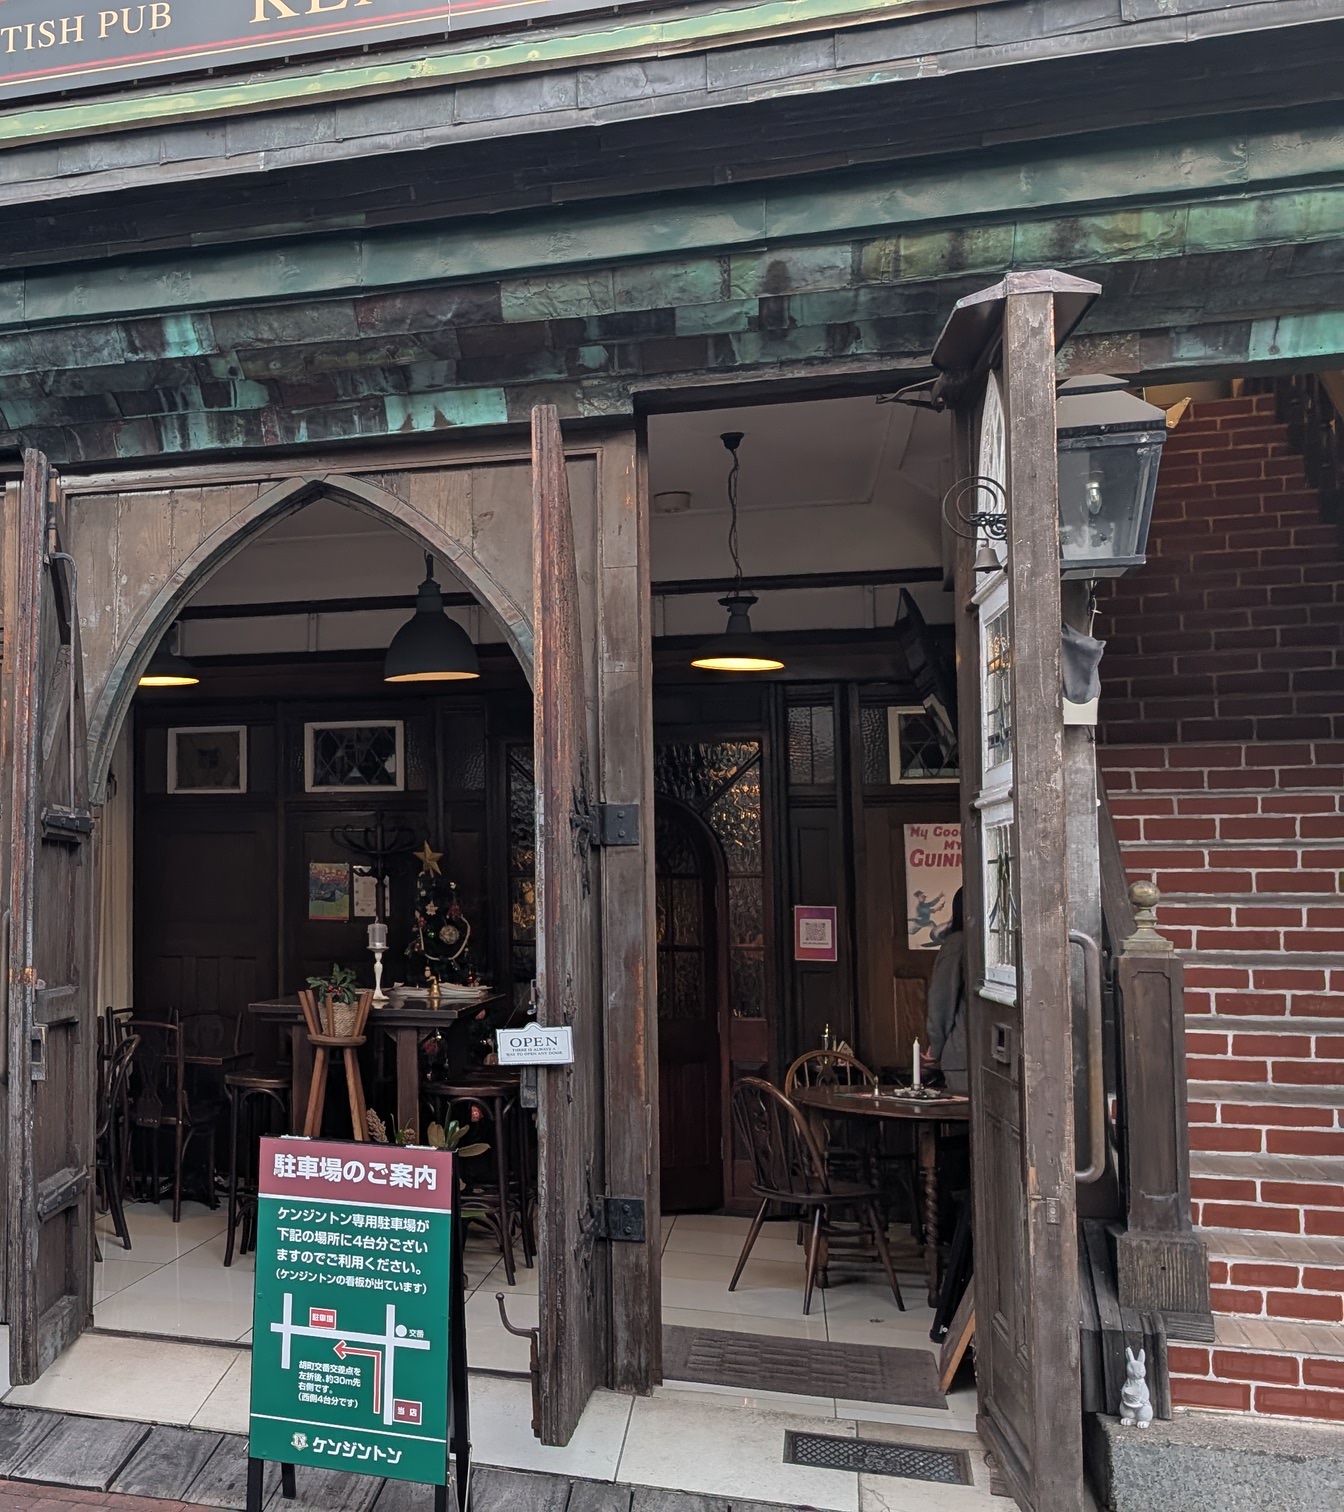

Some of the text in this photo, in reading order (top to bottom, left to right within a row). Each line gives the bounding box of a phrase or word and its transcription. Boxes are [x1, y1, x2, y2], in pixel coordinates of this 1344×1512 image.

[97, 2, 172, 39] PUB
[910, 826, 961, 840] My Goo
[509, 1036, 558, 1048] OPEN
[273, 1153, 437, 1191] 駐車場のご案内
[277, 1207, 430, 1233] ケンジントン専用駐車場が
[276, 1227, 428, 1253] 下記の場所に4台分ござい
[276, 1248, 422, 1276] ますのでご利用ください。
[276, 1268, 427, 1295] (ケンジントンの看板が出ています)
[311, 1312, 334, 1323] 駐車場
[408, 1328, 424, 1338] 交番
[298, 1392, 359, 1409] (西側4台分です)
[312, 1436, 402, 1464] ケンジントン
